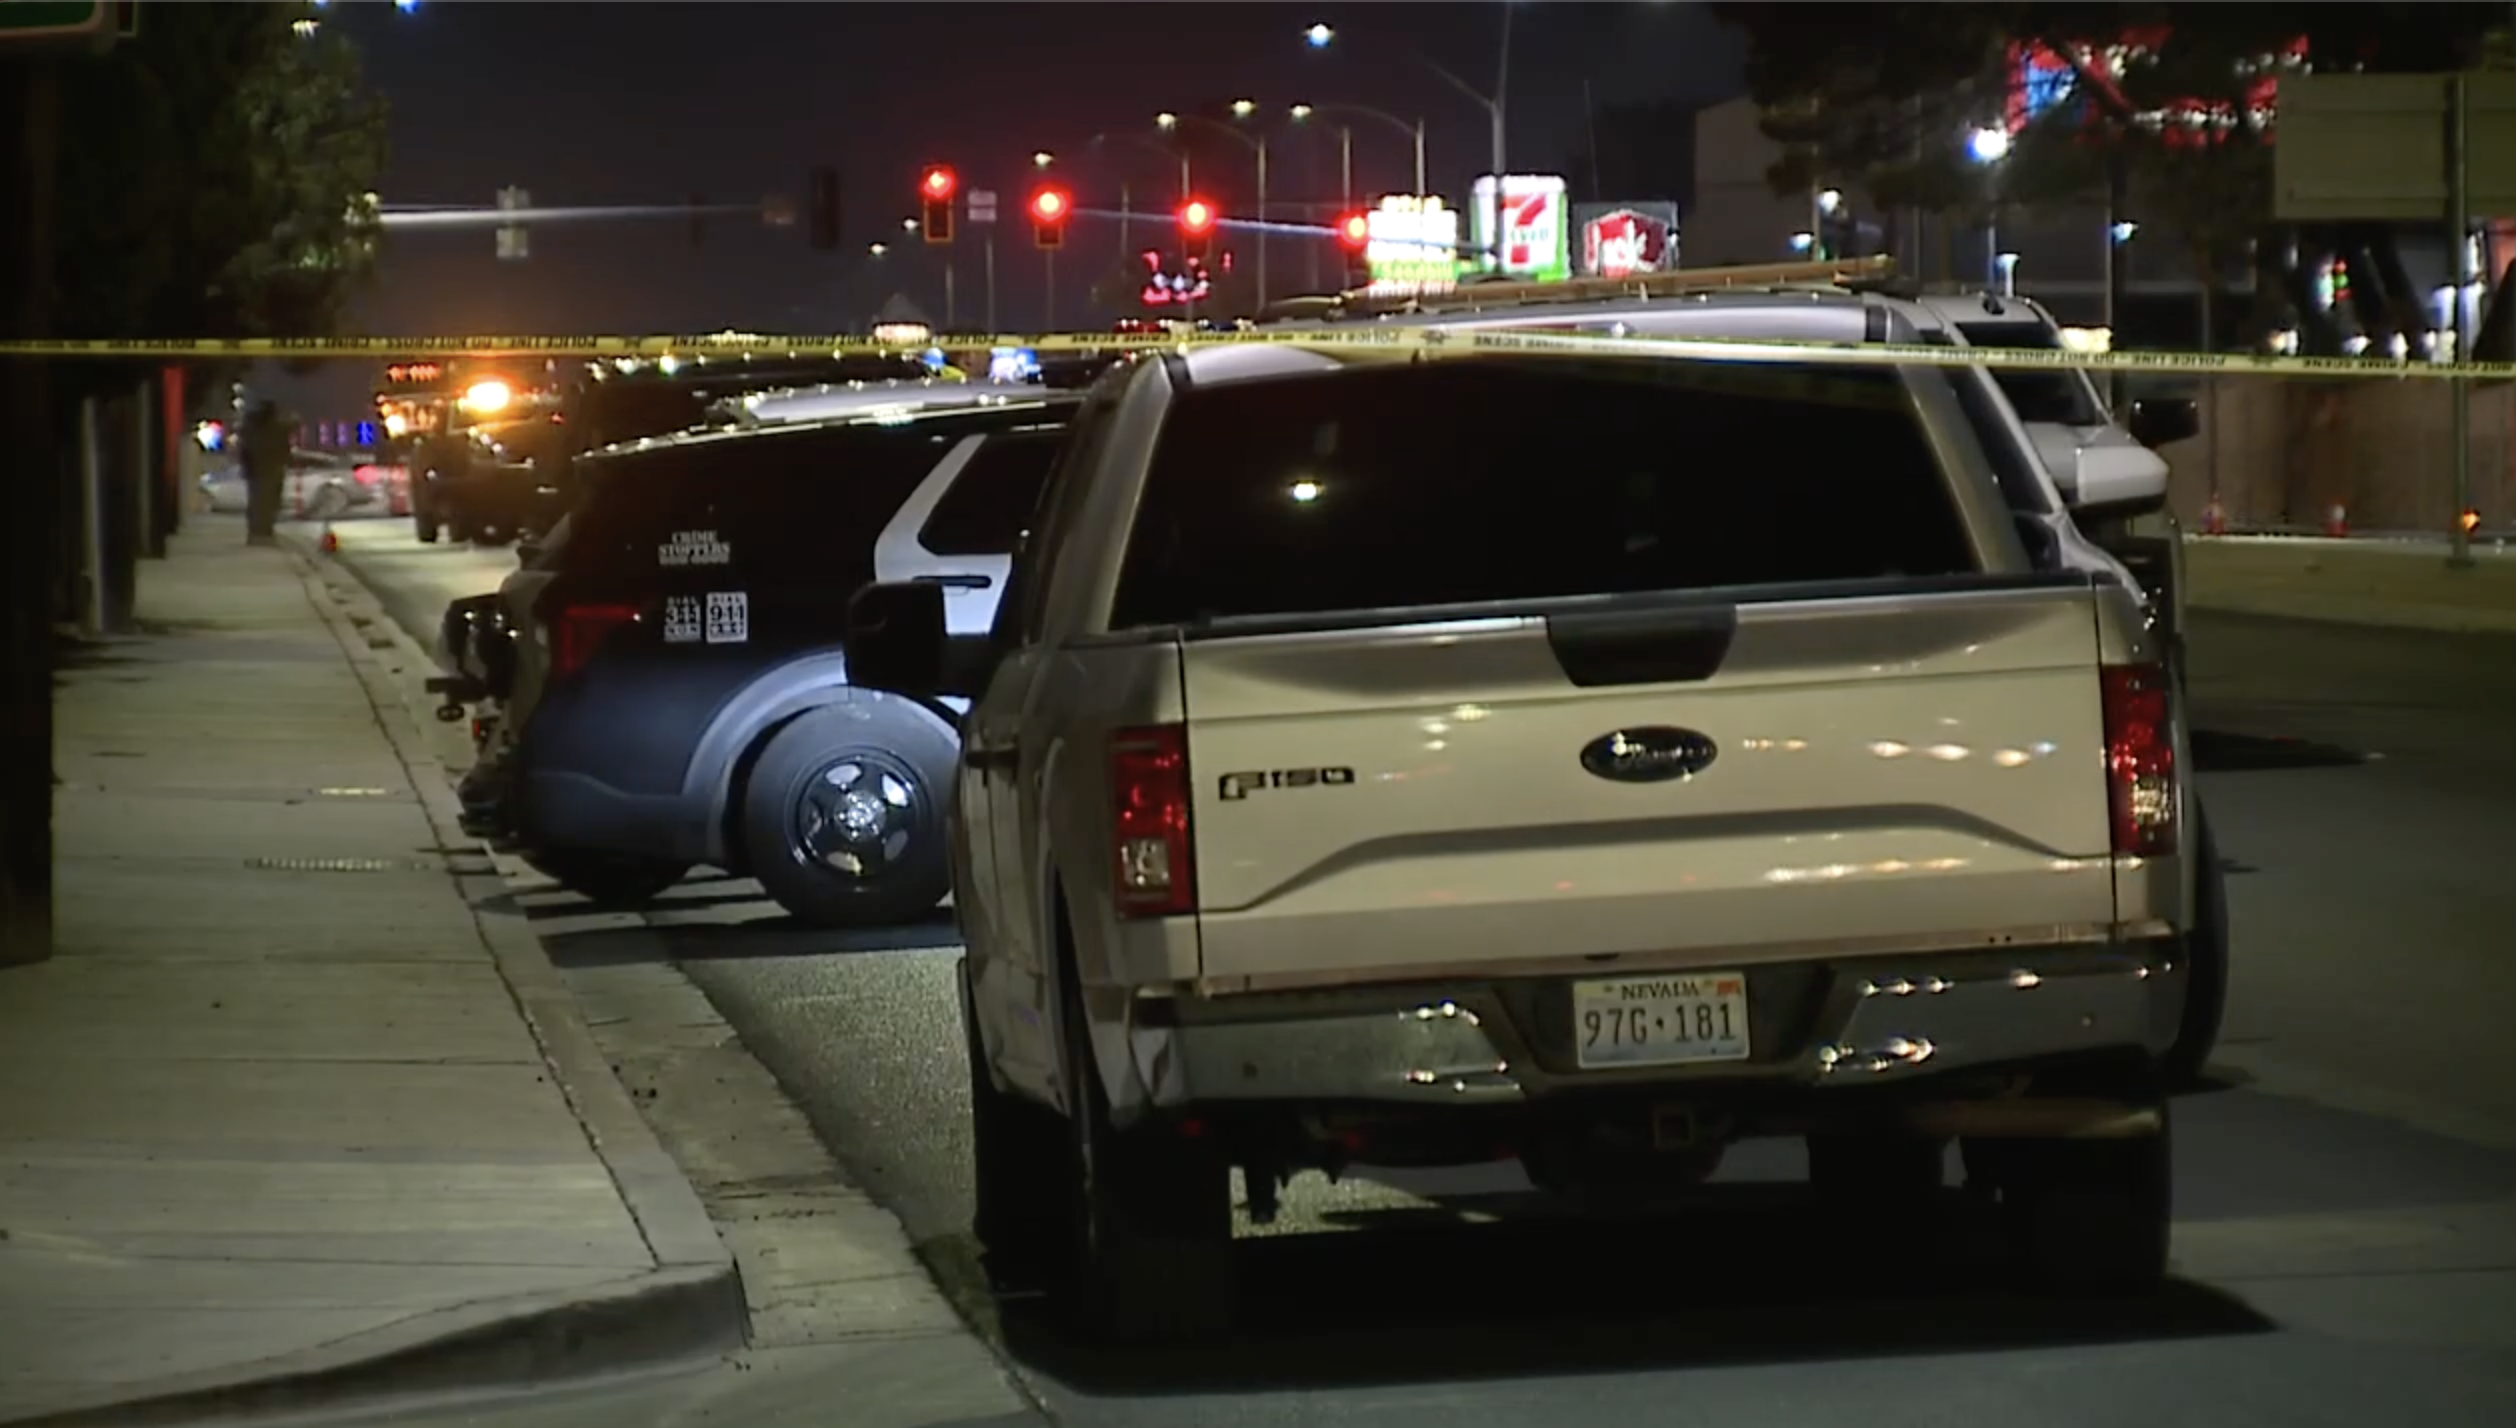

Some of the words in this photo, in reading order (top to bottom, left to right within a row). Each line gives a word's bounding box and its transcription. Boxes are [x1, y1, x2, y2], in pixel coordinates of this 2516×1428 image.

[548, 336, 597, 348] POLICE
[948, 335, 997, 345] POLICE
[1070, 334, 1117, 344] SCENE
[1348, 330, 1400, 343] POLICE
[1473, 336, 1521, 348] SCENE
[2060, 352, 2089, 362] NOT
[2092, 352, 2115, 363] DO
[2134, 354, 2165, 365] LINE
[2174, 355, 2226, 366] POLICE
[2304, 359, 2352, 369] SCENE
[2359, 360, 2410, 369] CRIME
[671, 530, 718, 543] CRIME
[657, 543, 731, 557] STOPPERS
[1621, 981, 1700, 1000] NEVADA
